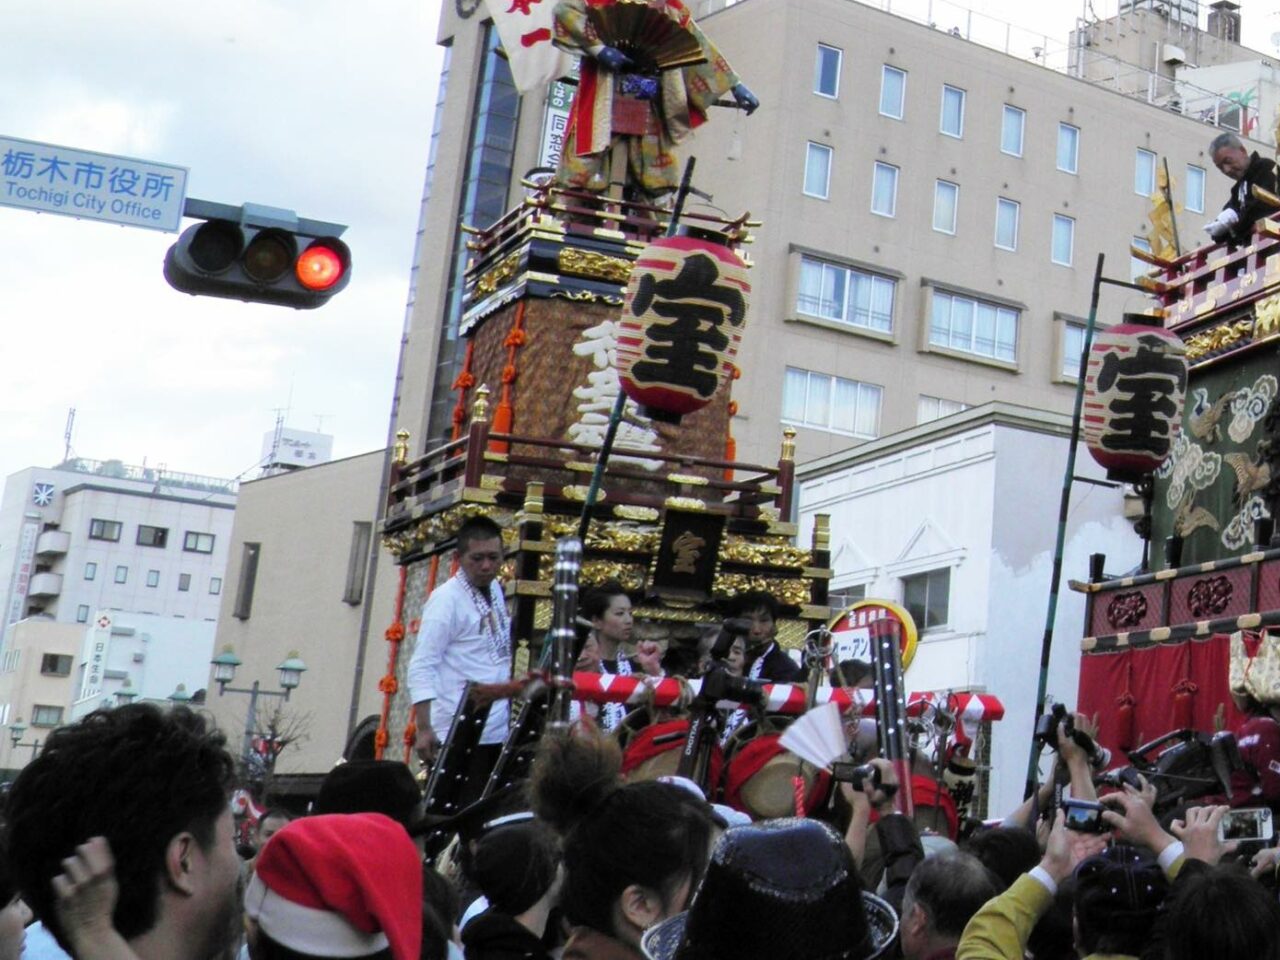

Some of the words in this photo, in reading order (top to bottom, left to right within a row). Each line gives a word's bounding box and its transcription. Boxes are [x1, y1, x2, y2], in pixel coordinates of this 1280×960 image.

[1, 149, 175, 203] 栃木市役所
[6, 181, 69, 207] Tochigi
[73, 192, 107, 214] City
[111, 198, 162, 221] Office
